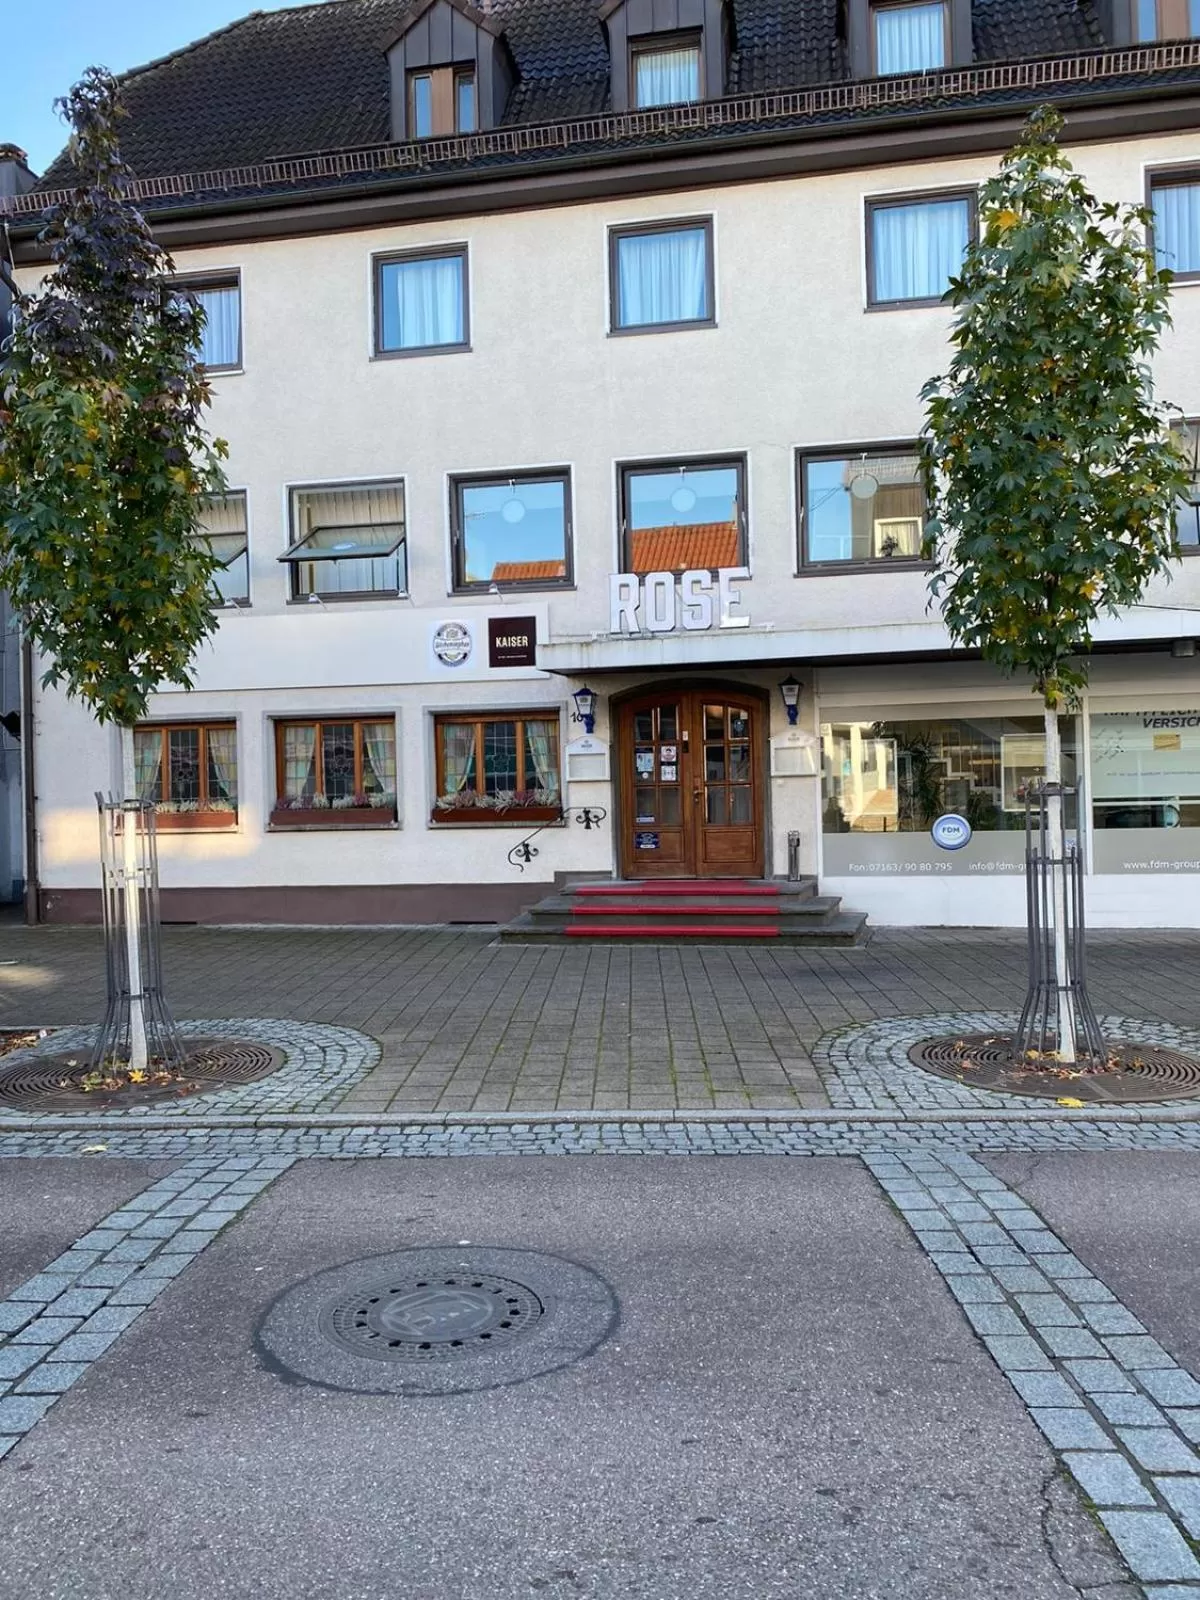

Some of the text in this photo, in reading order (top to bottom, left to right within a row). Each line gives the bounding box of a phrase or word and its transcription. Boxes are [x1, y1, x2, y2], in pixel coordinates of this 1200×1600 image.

[608, 566, 752, 635] ROSE
[495, 635, 529, 648] KAISER
[942, 826, 960, 834] FDM
[904, 863, 917, 872] 90
[920, 863, 932, 872] 80
[934, 862, 953, 872] 795
